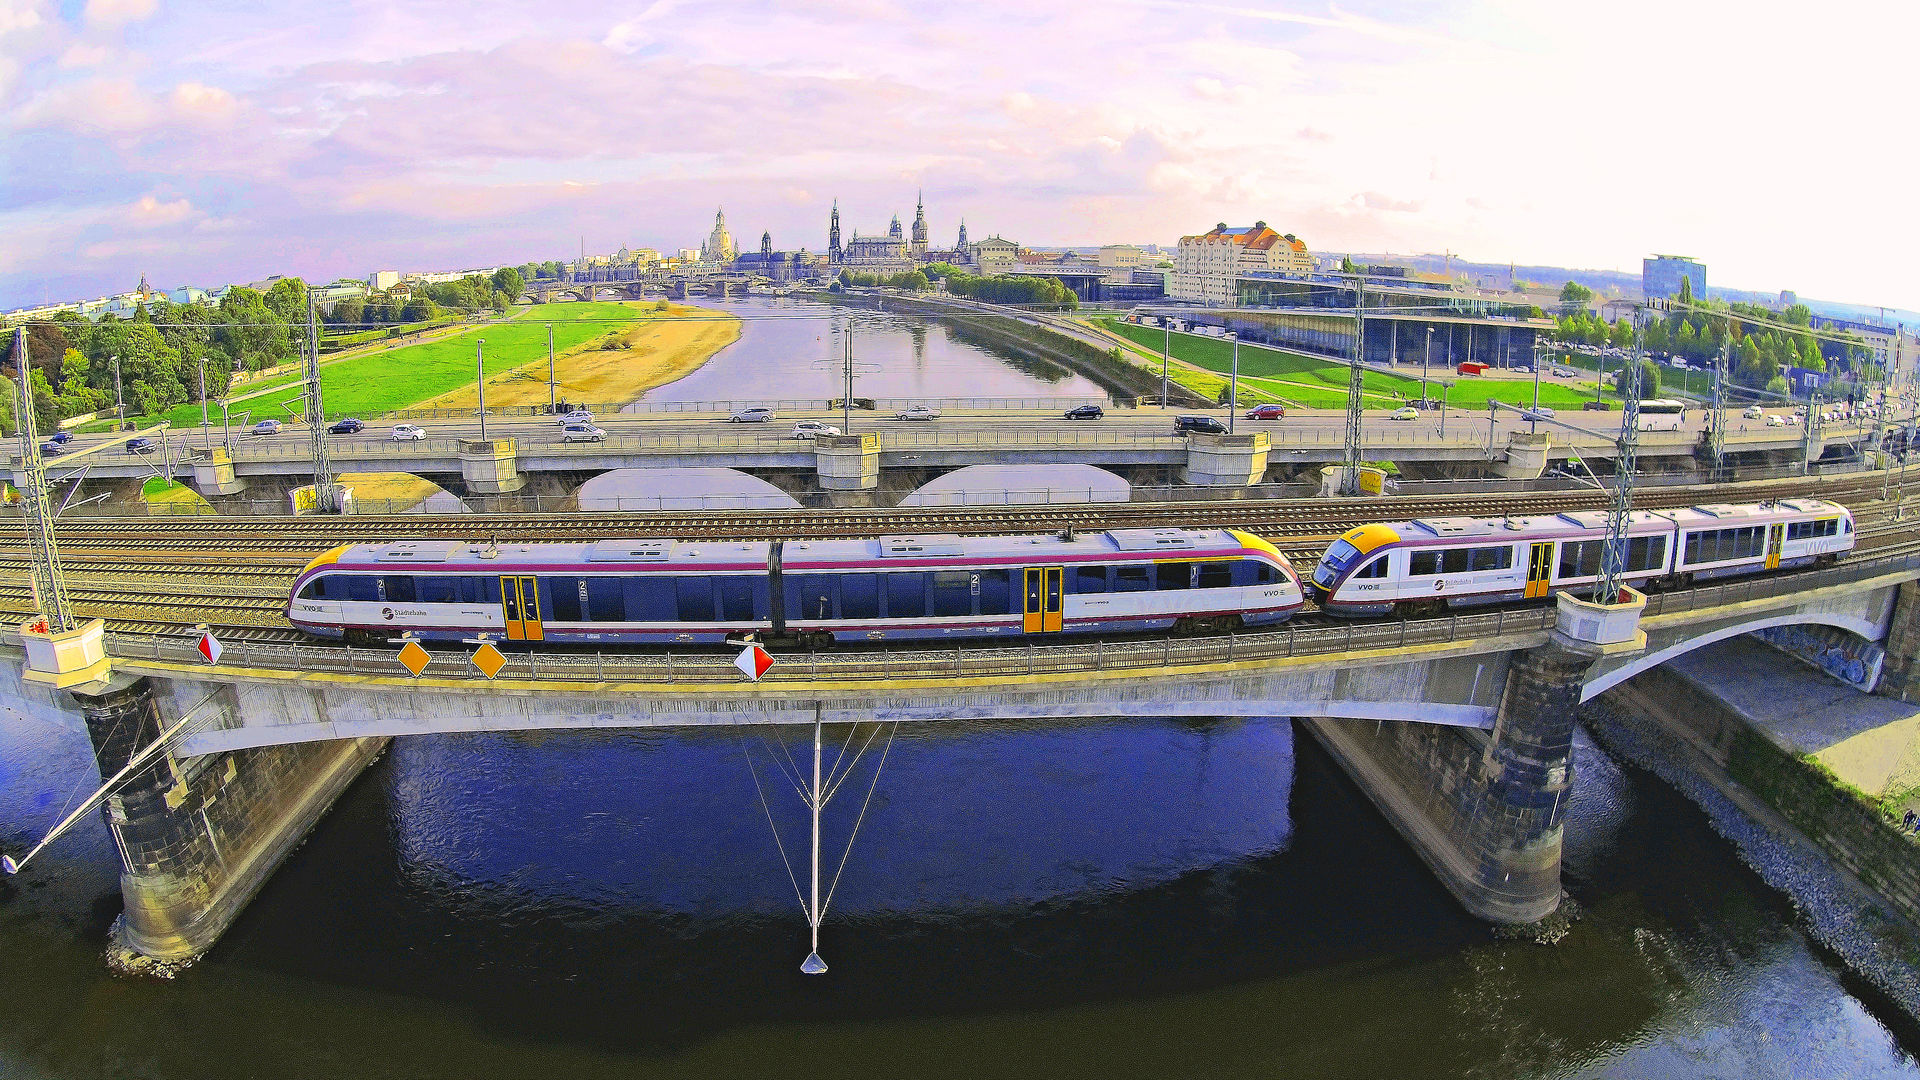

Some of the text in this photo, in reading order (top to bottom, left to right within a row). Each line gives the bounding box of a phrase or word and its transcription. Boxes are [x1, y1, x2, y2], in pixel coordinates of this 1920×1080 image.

[1437, 553, 1443, 562] 2
[972, 574, 978, 584] 2
[378, 580, 384, 589] 2
[579, 581, 586, 590] 2
